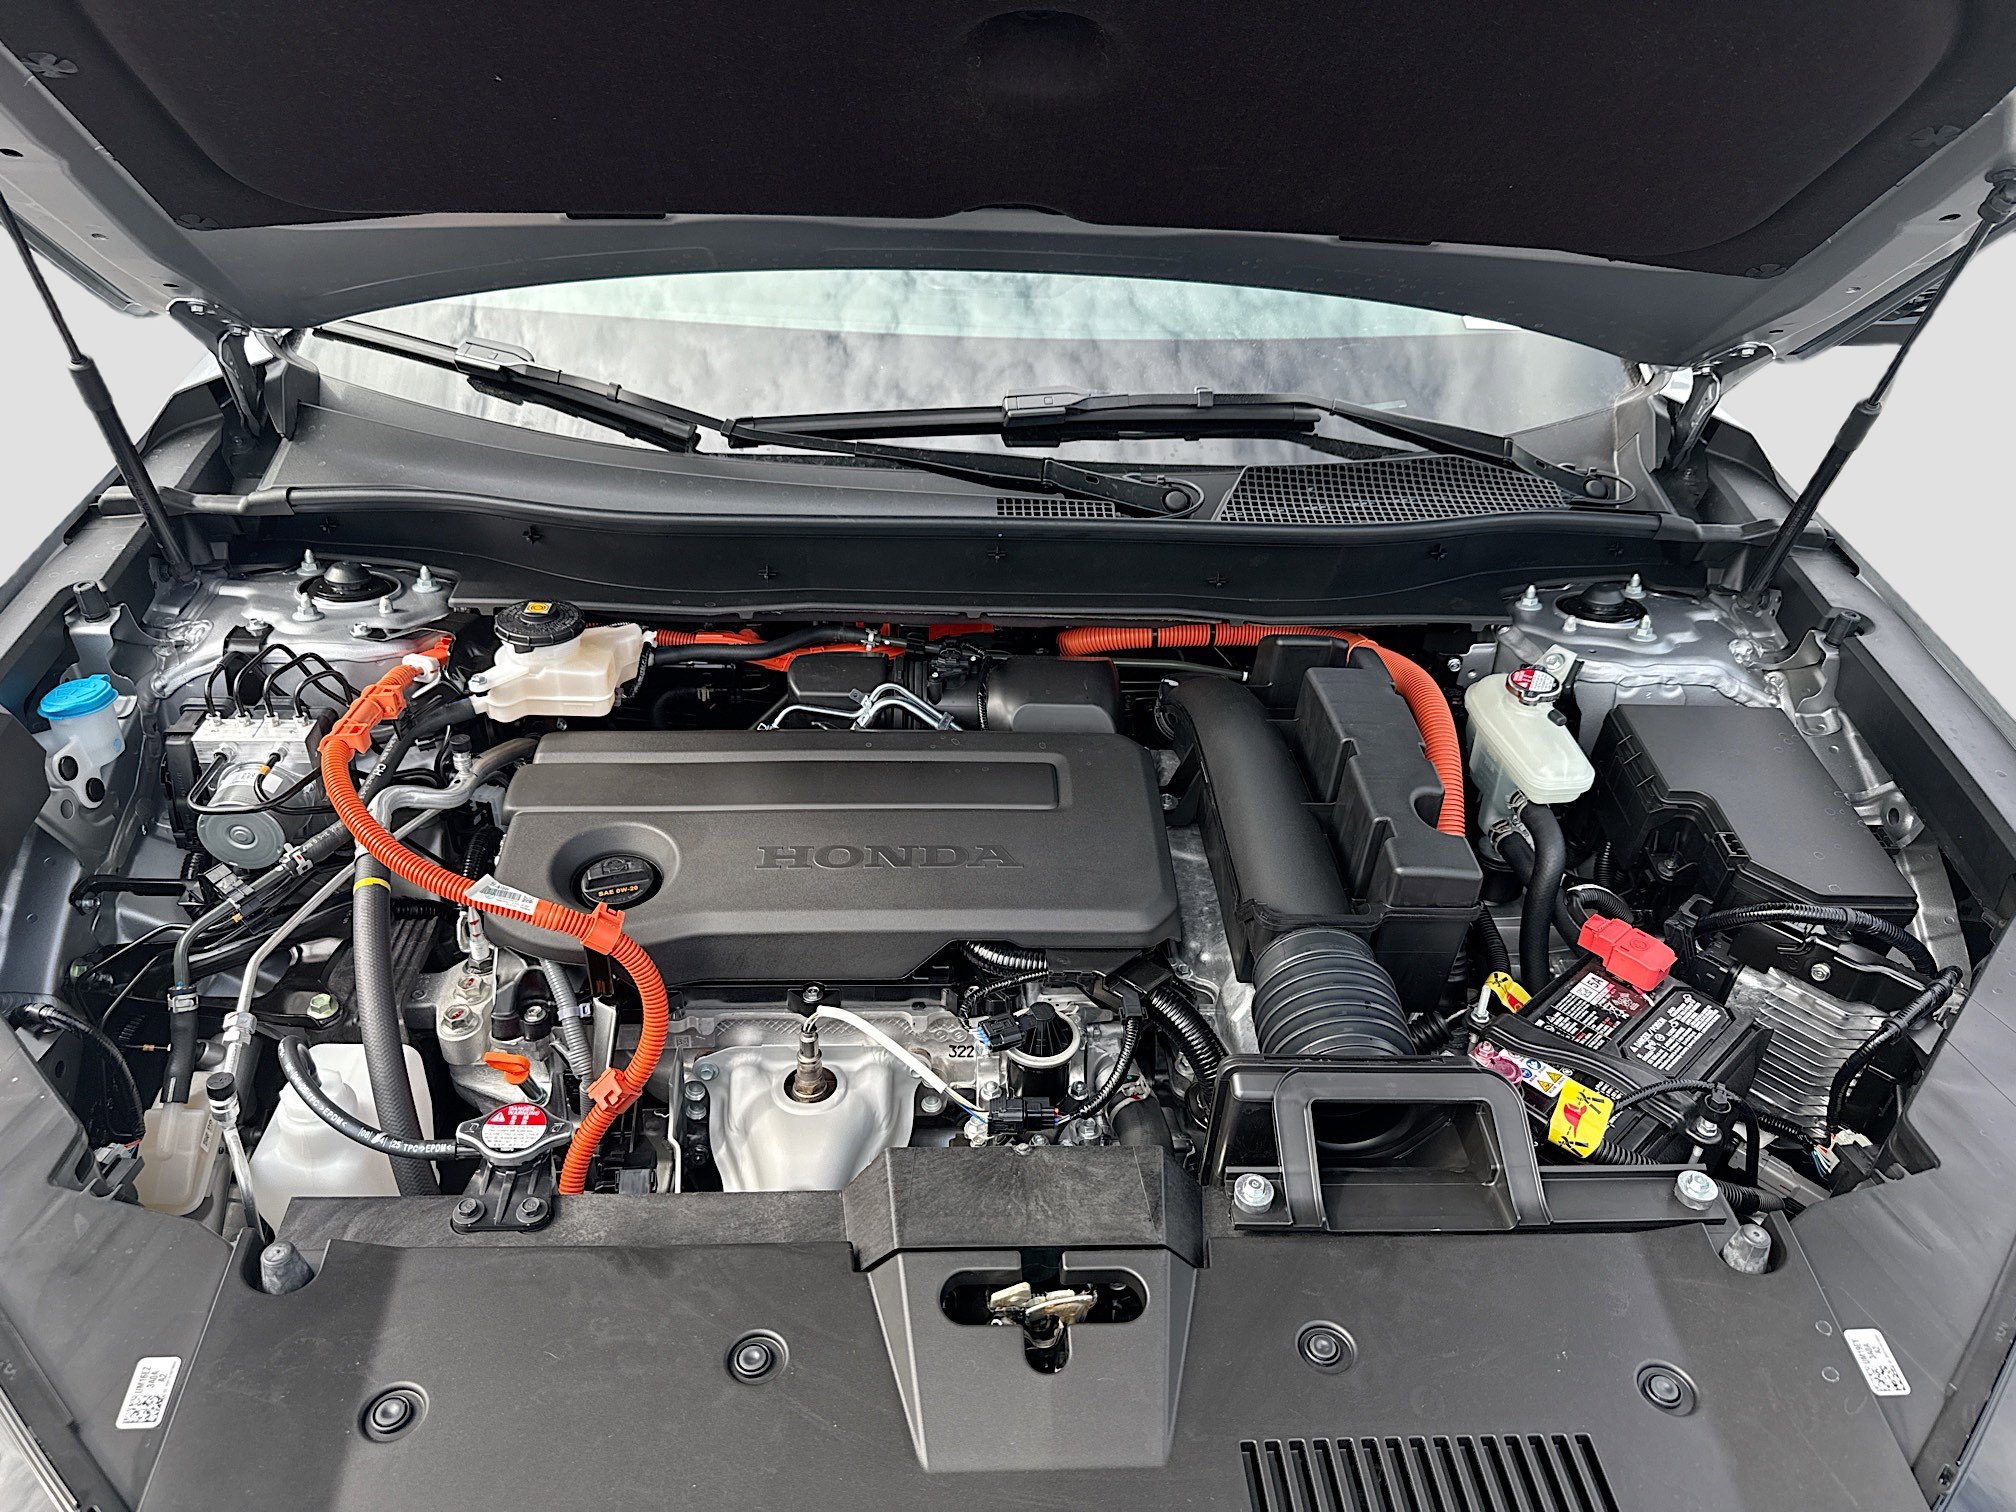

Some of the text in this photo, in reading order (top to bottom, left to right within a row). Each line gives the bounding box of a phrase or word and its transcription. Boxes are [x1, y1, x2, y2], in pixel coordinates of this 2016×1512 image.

[754, 844, 1025, 870] HONDA
[615, 885, 639, 893] 0W-20
[1588, 976, 1605, 989] 5A
[948, 1044, 975, 1058] 322
